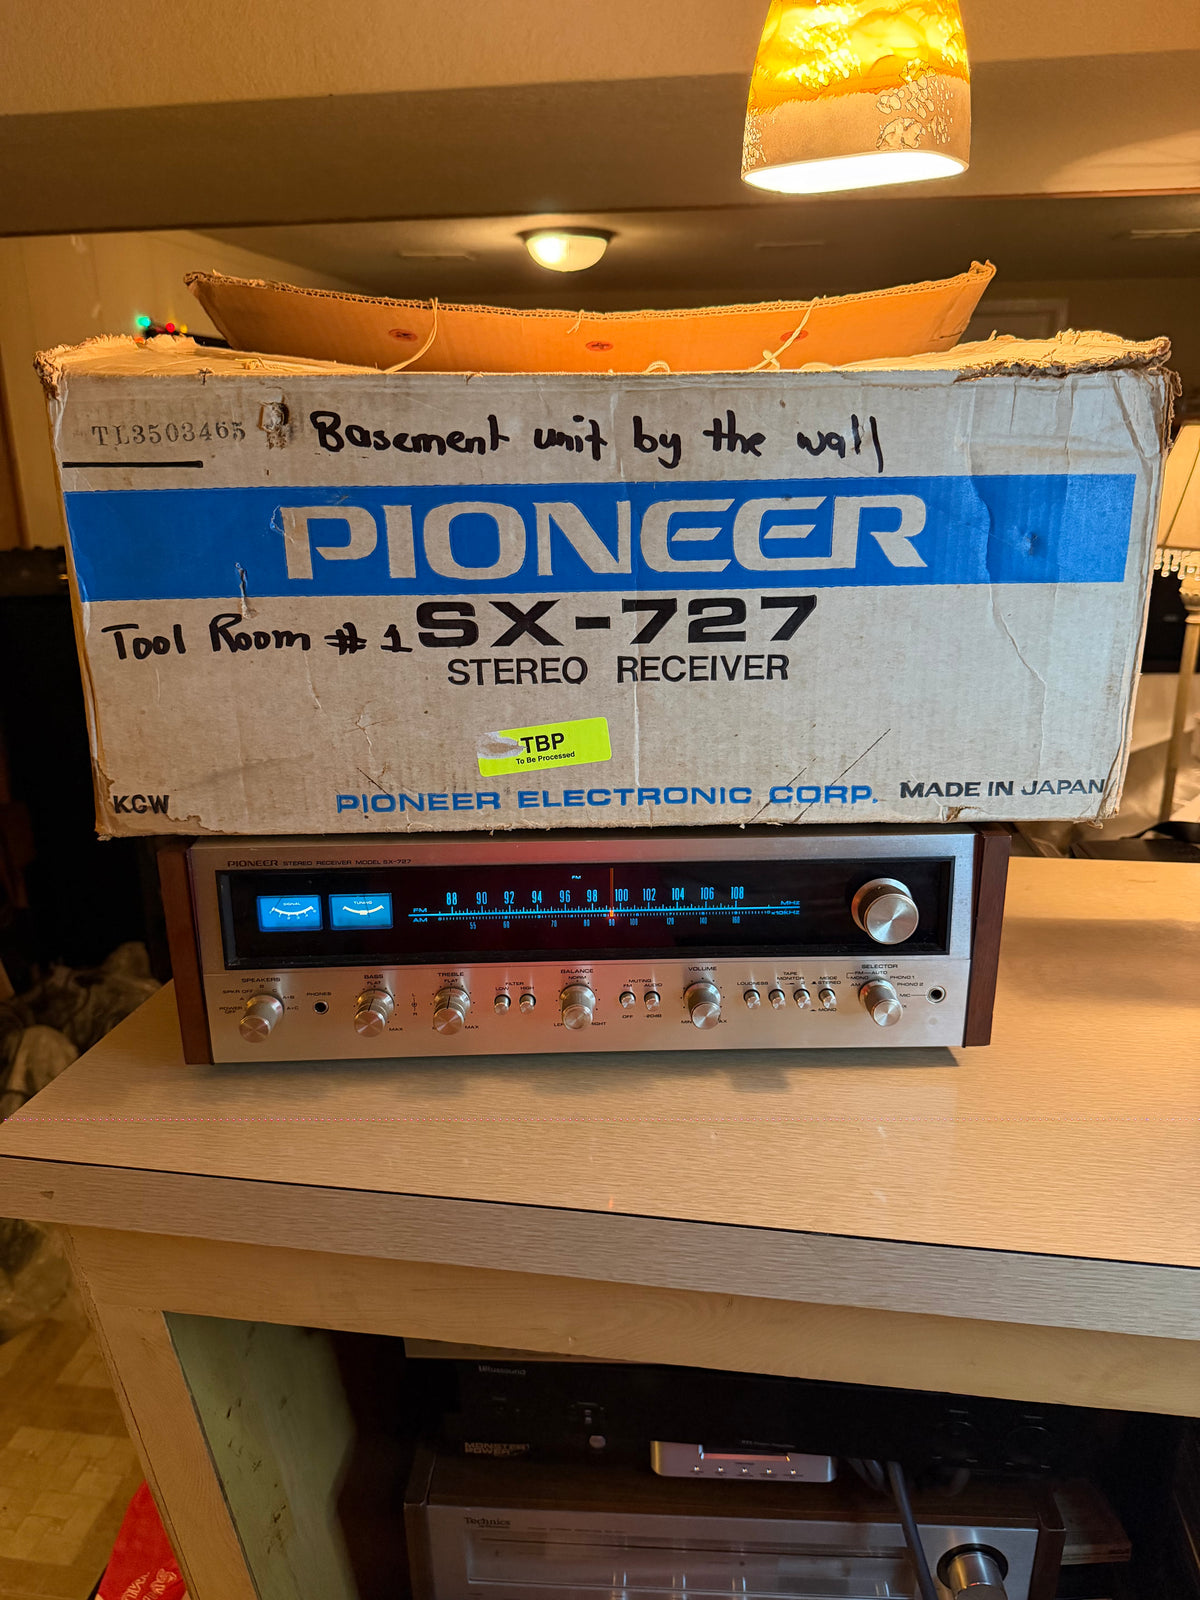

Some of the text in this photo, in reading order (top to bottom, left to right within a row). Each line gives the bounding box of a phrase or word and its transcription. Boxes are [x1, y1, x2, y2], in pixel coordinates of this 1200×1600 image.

[91, 421, 246, 446] TL3503465
[310, 410, 884, 474] Basement unit by the wall
[279, 494, 928, 581] PIONEER
[416, 594, 818, 649] SX-727
[101, 622, 187, 661] Tool
[208, 613, 311, 654] Room
[447, 654, 790, 686] STEREO RECEIVER
[520, 732, 565, 754] TBP
[538, 751, 576, 762] Processed
[337, 785, 879, 814] PIONEER ELECTRONIC CORP.
[900, 778, 1105, 799] MADE IN JAPAN
[227, 860, 278, 868] PIONEER
[446, 886, 744, 905] 88 90 92 94 96 98 100 102 104 106 108
[464, 1516, 511, 1526] Technics
